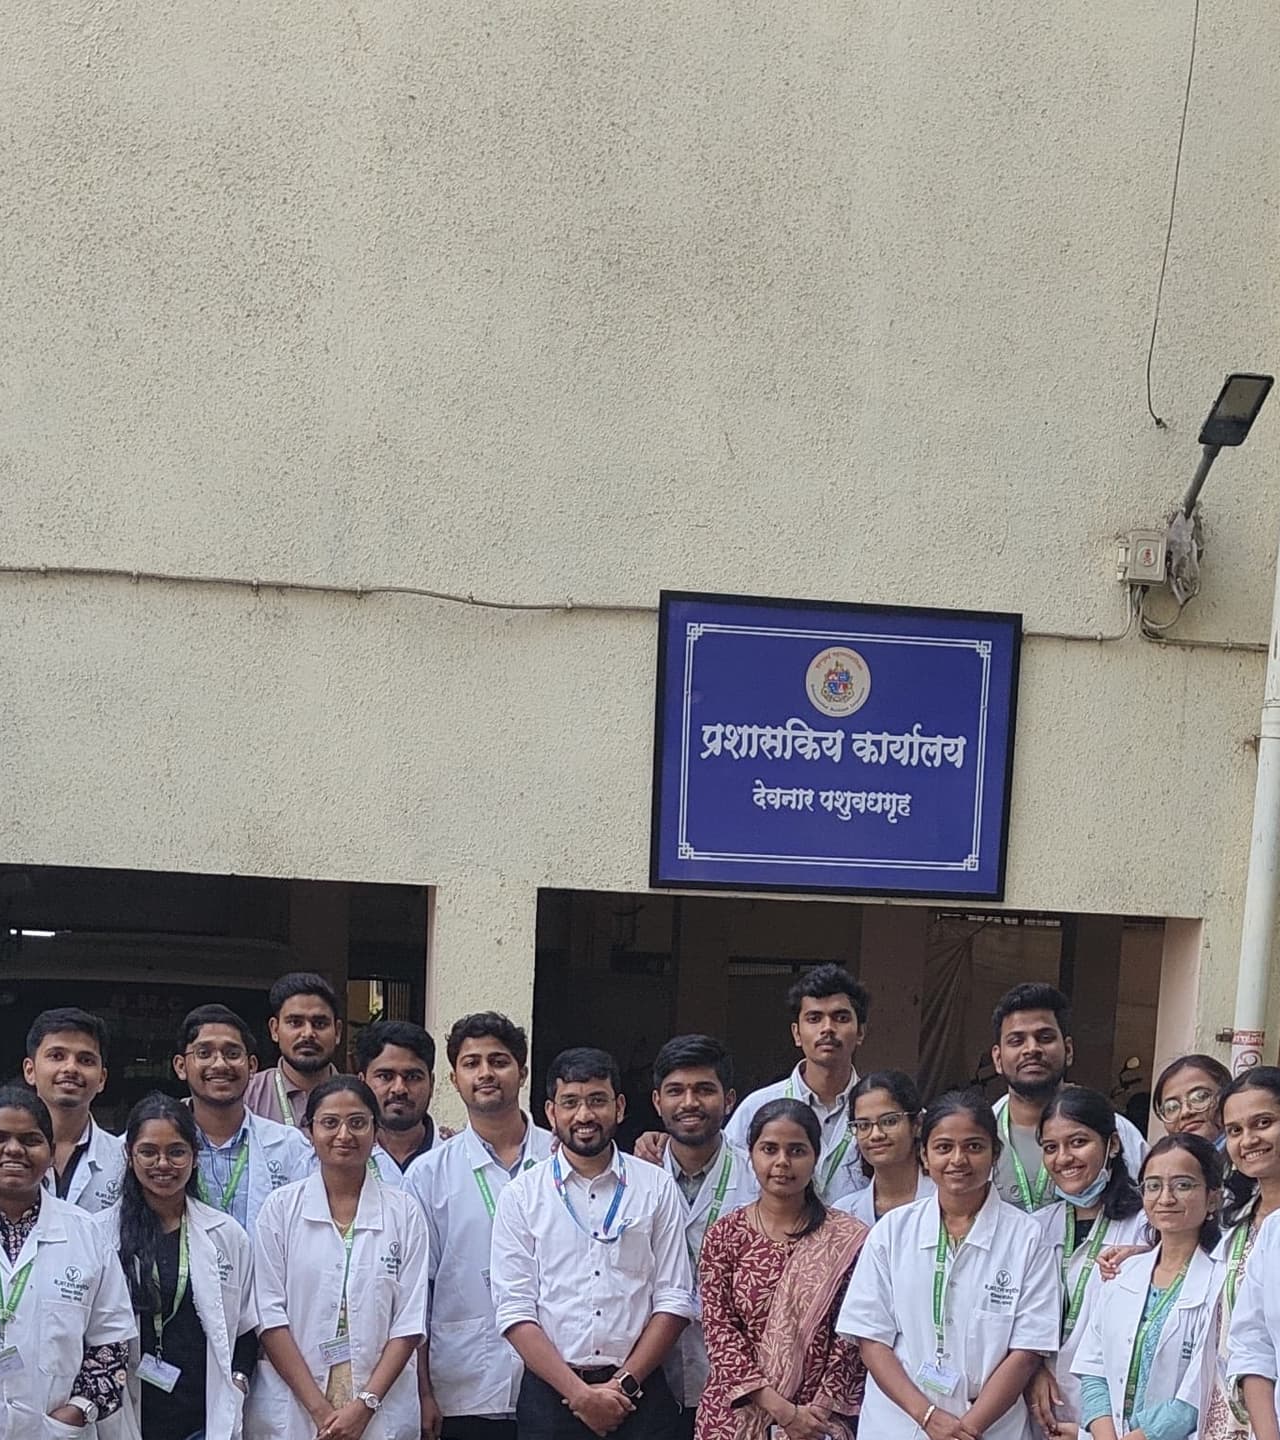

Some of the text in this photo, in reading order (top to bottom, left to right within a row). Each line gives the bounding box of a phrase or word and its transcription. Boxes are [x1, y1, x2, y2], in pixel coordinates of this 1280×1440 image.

[852, 723, 967, 769] कार्यालय
[752, 780, 911, 823] देवनार पशुवधगृह
